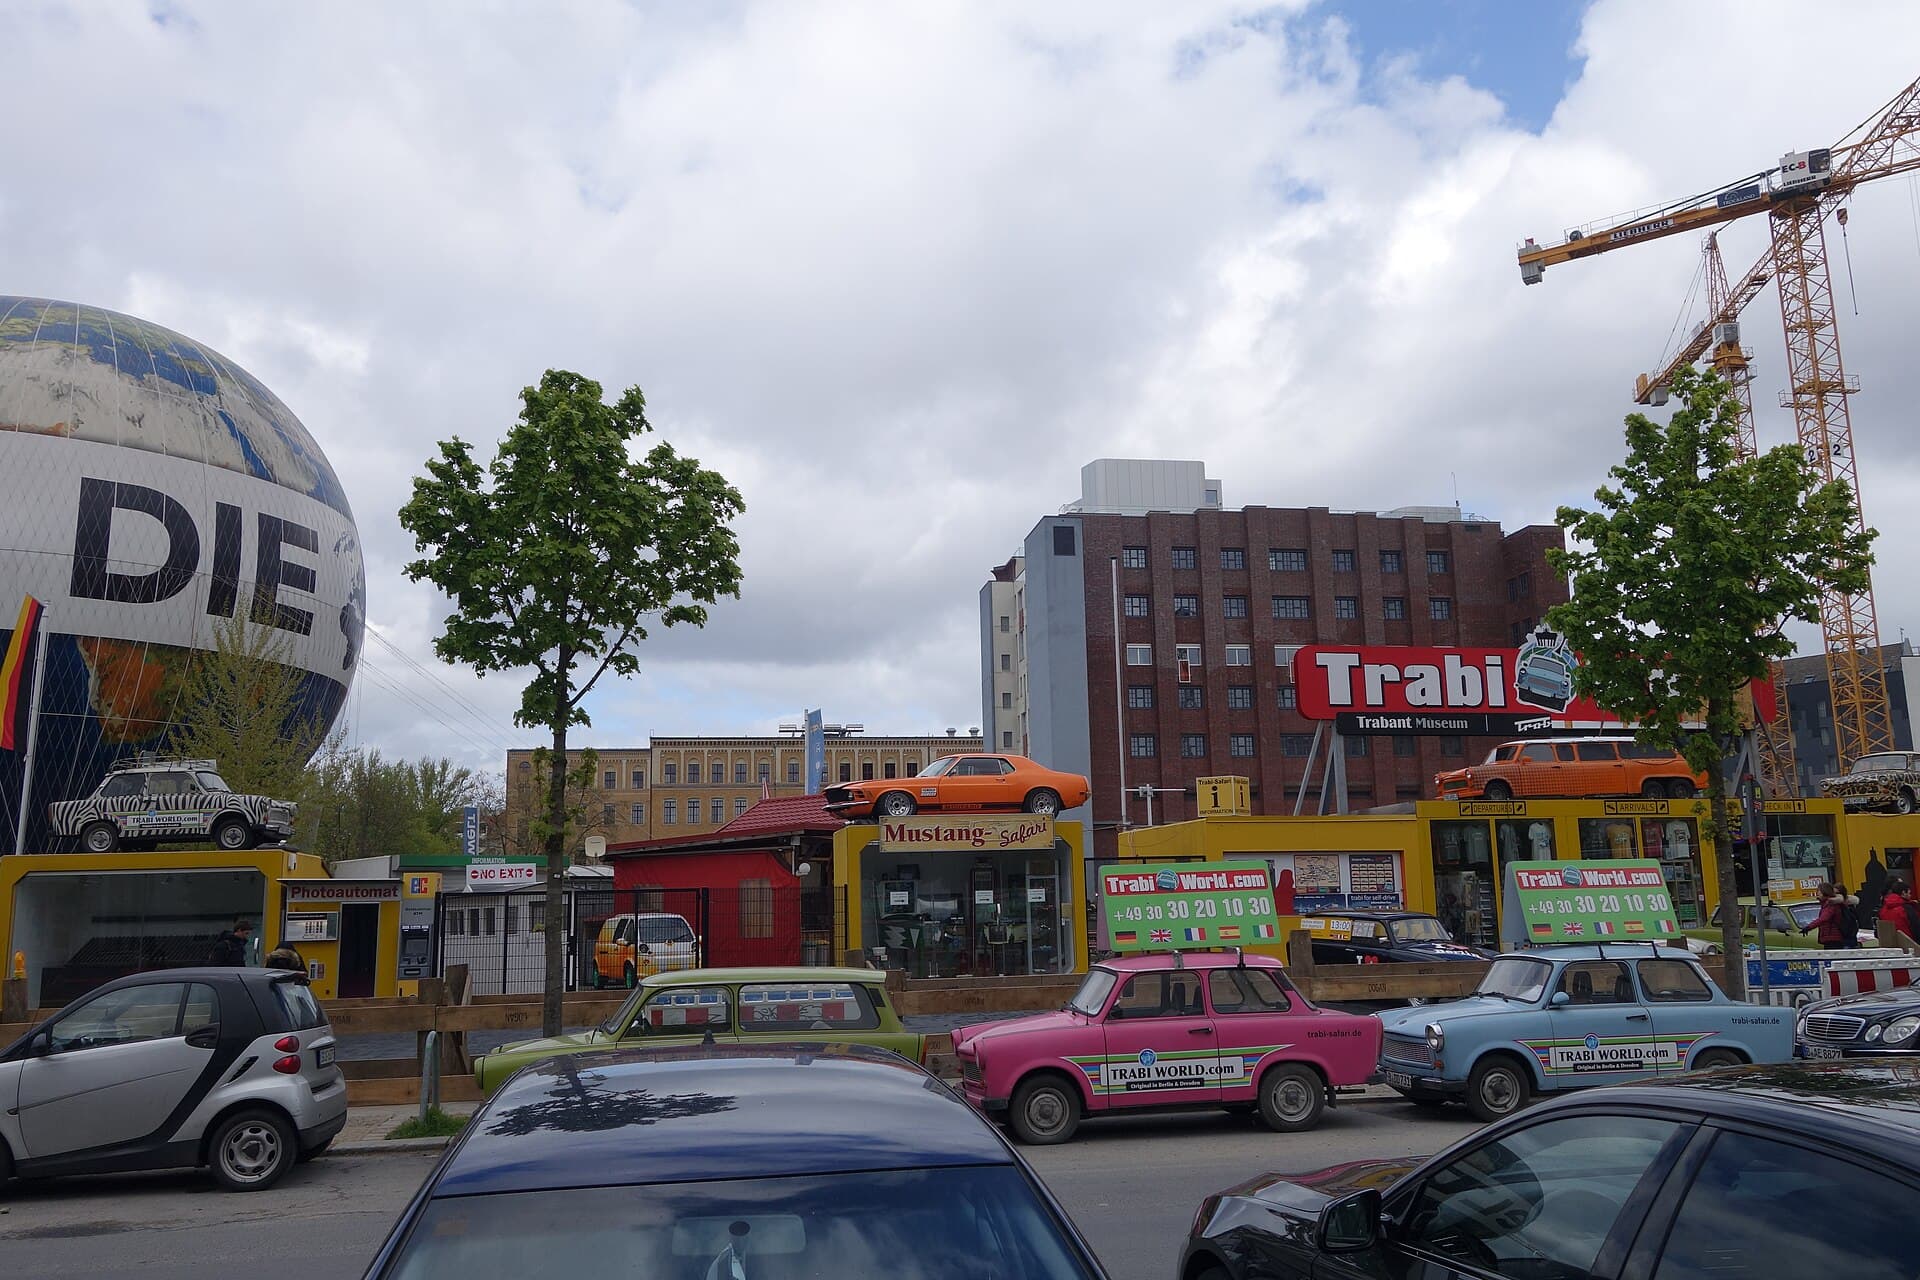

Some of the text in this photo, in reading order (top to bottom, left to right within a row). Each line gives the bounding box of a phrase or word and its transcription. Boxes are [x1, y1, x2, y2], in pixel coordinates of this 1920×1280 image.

[1781, 160, 1807, 174] EC-B
[1833, 444, 1841, 456] 2
[69, 476, 319, 637] DIE
[1315, 652, 1505, 707] Trabi
[1356, 716, 1468, 729] Trabant Museum
[1473, 804, 1513, 813] DEPARTURES
[1619, 802, 1655, 812] ARRIVALS
[1764, 802, 1781, 810] HECK
[885, 817, 1048, 847] Mustang- Safari
[480, 868, 524, 879] NO EXIT
[1517, 870, 1661, 888] Trabi World.com
[1106, 873, 1265, 893] Trabi World.com
[290, 885, 399, 899] Photoautomat
[1113, 896, 1271, 922] +49 30 30 20 10 30
[1528, 893, 1669, 915] +49 30 30 20 10 30
[1331, 920, 1351, 930] 13:00
[1368, 983, 1387, 993] DOGAN
[1731, 1017, 1780, 1025] trabi-safari.de
[1307, 1030, 1362, 1038] trabi-safari.de
[1559, 1048, 1669, 1062] TRABI WORLD.com
[1110, 1064, 1234, 1080] TRABI WORLD.com
[1577, 1063, 1595, 1071] Original
[1130, 1081, 1151, 1090] Original
